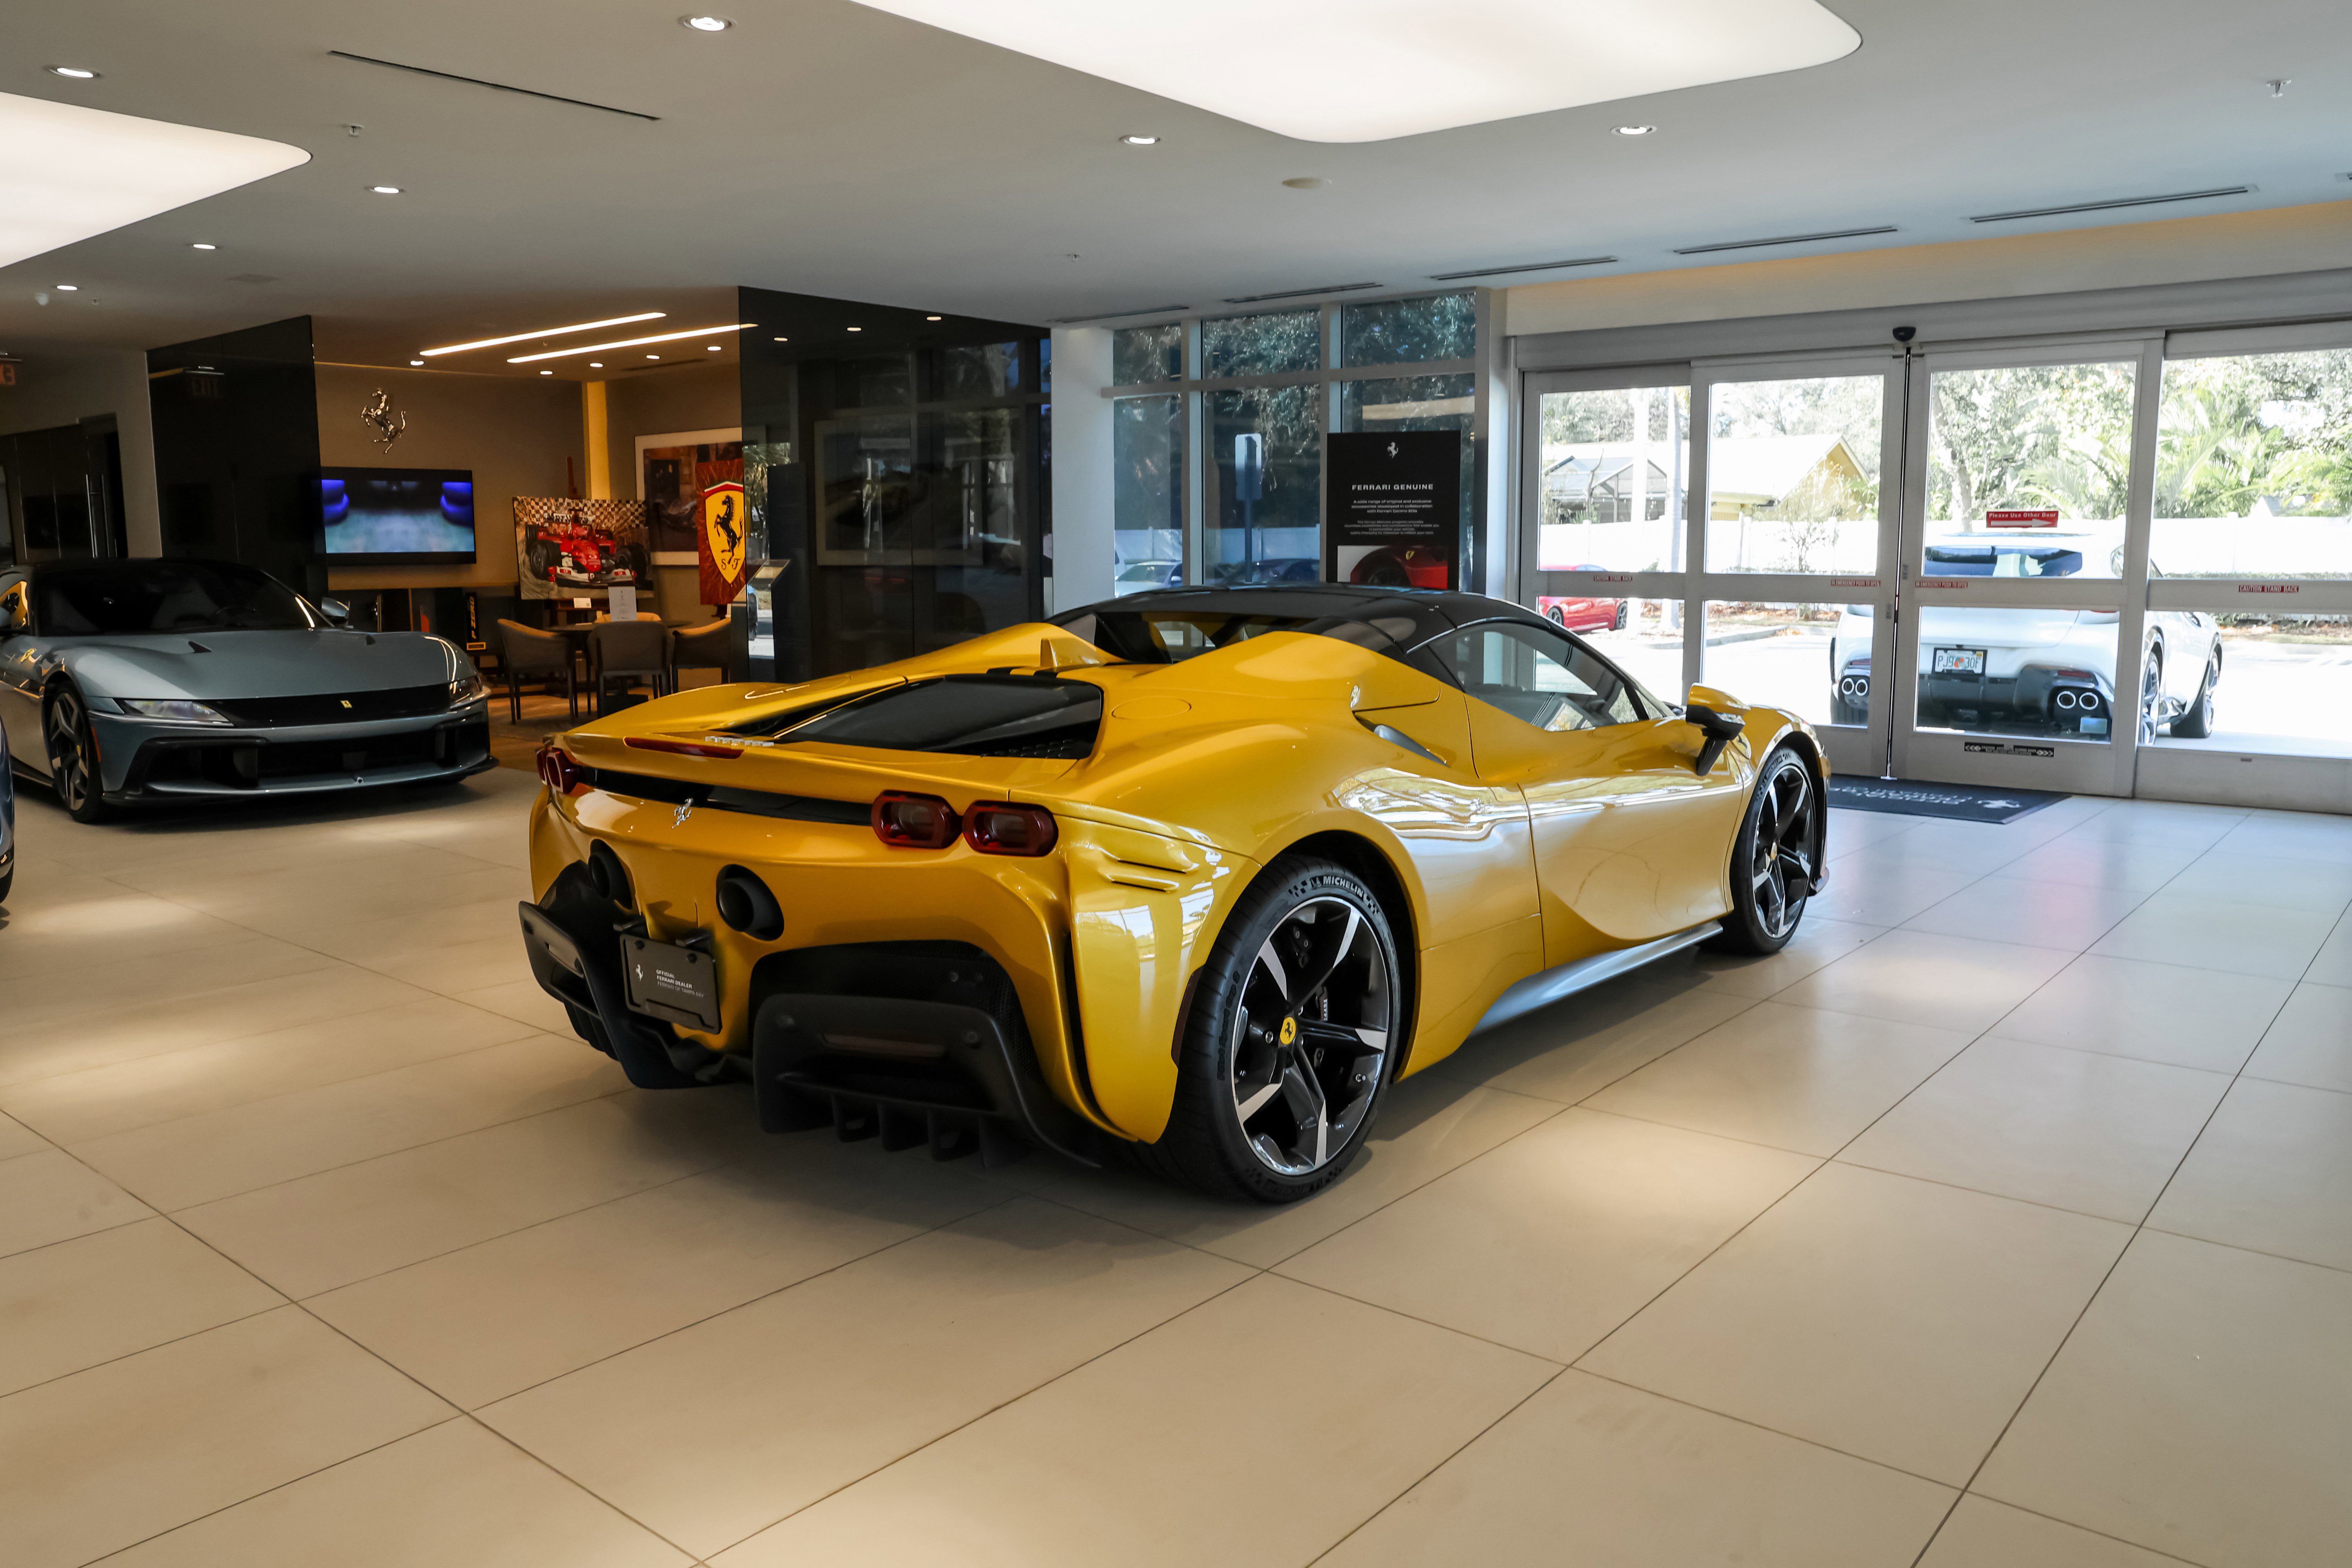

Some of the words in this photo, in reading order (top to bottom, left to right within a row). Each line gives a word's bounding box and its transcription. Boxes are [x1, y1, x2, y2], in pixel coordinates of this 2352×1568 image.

[471, 630, 477, 639] P
[1323, 875, 1363, 898] MICHELIN
[656, 969, 675, 979] OFFICIAL
[657, 975, 675, 984] FERRARI
[675, 980, 692, 989] DEALER
[657, 981, 675, 990] FERRARI
